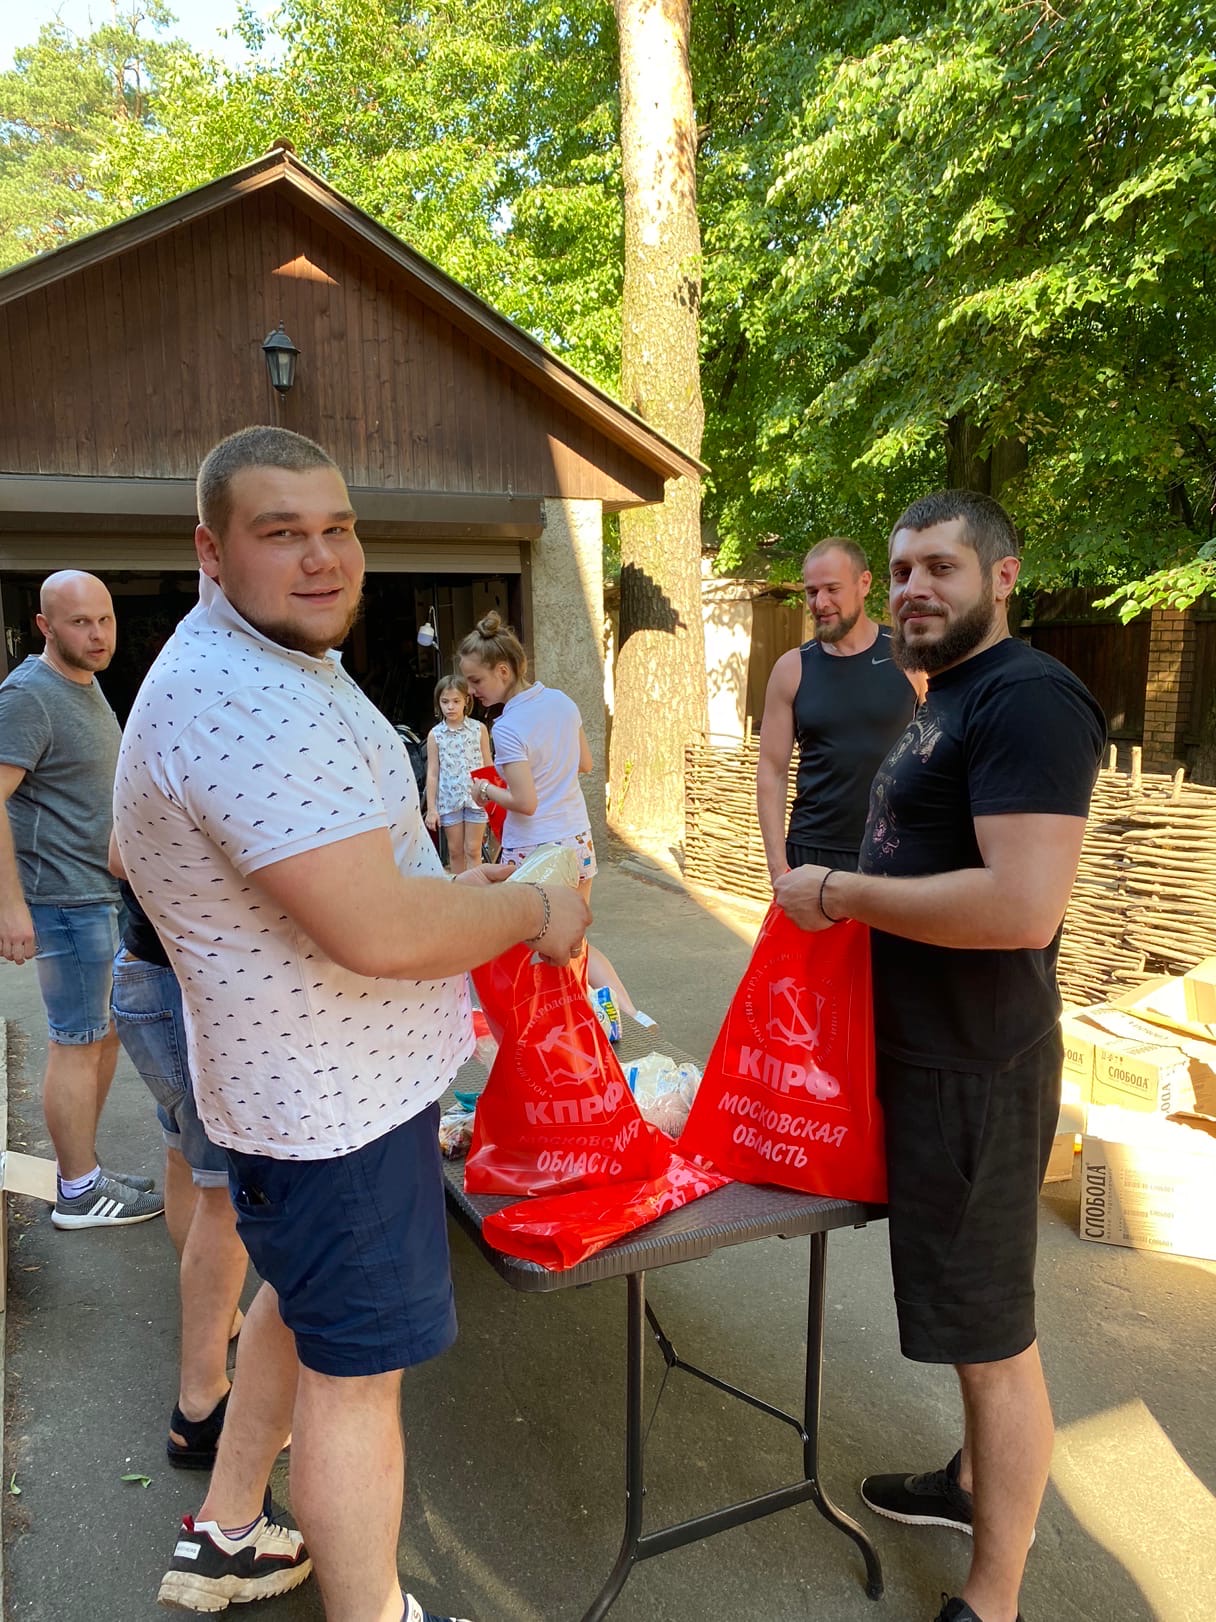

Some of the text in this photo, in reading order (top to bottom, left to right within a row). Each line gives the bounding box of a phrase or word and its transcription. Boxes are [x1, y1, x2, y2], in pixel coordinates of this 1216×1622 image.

[738, 1045, 841, 1100] КПРФ
[1108, 1065, 1149, 1089] СЛОБОДА
[524, 1080, 625, 1125] КПРФ
[718, 1091, 848, 1148] МОСКОВСКАЯ
[537, 1150, 622, 1175] ОБЛАСТЬ
[732, 1123, 808, 1168] ОБЛАСТЬ
[1085, 1165, 1106, 1238] СЛОБОДА
